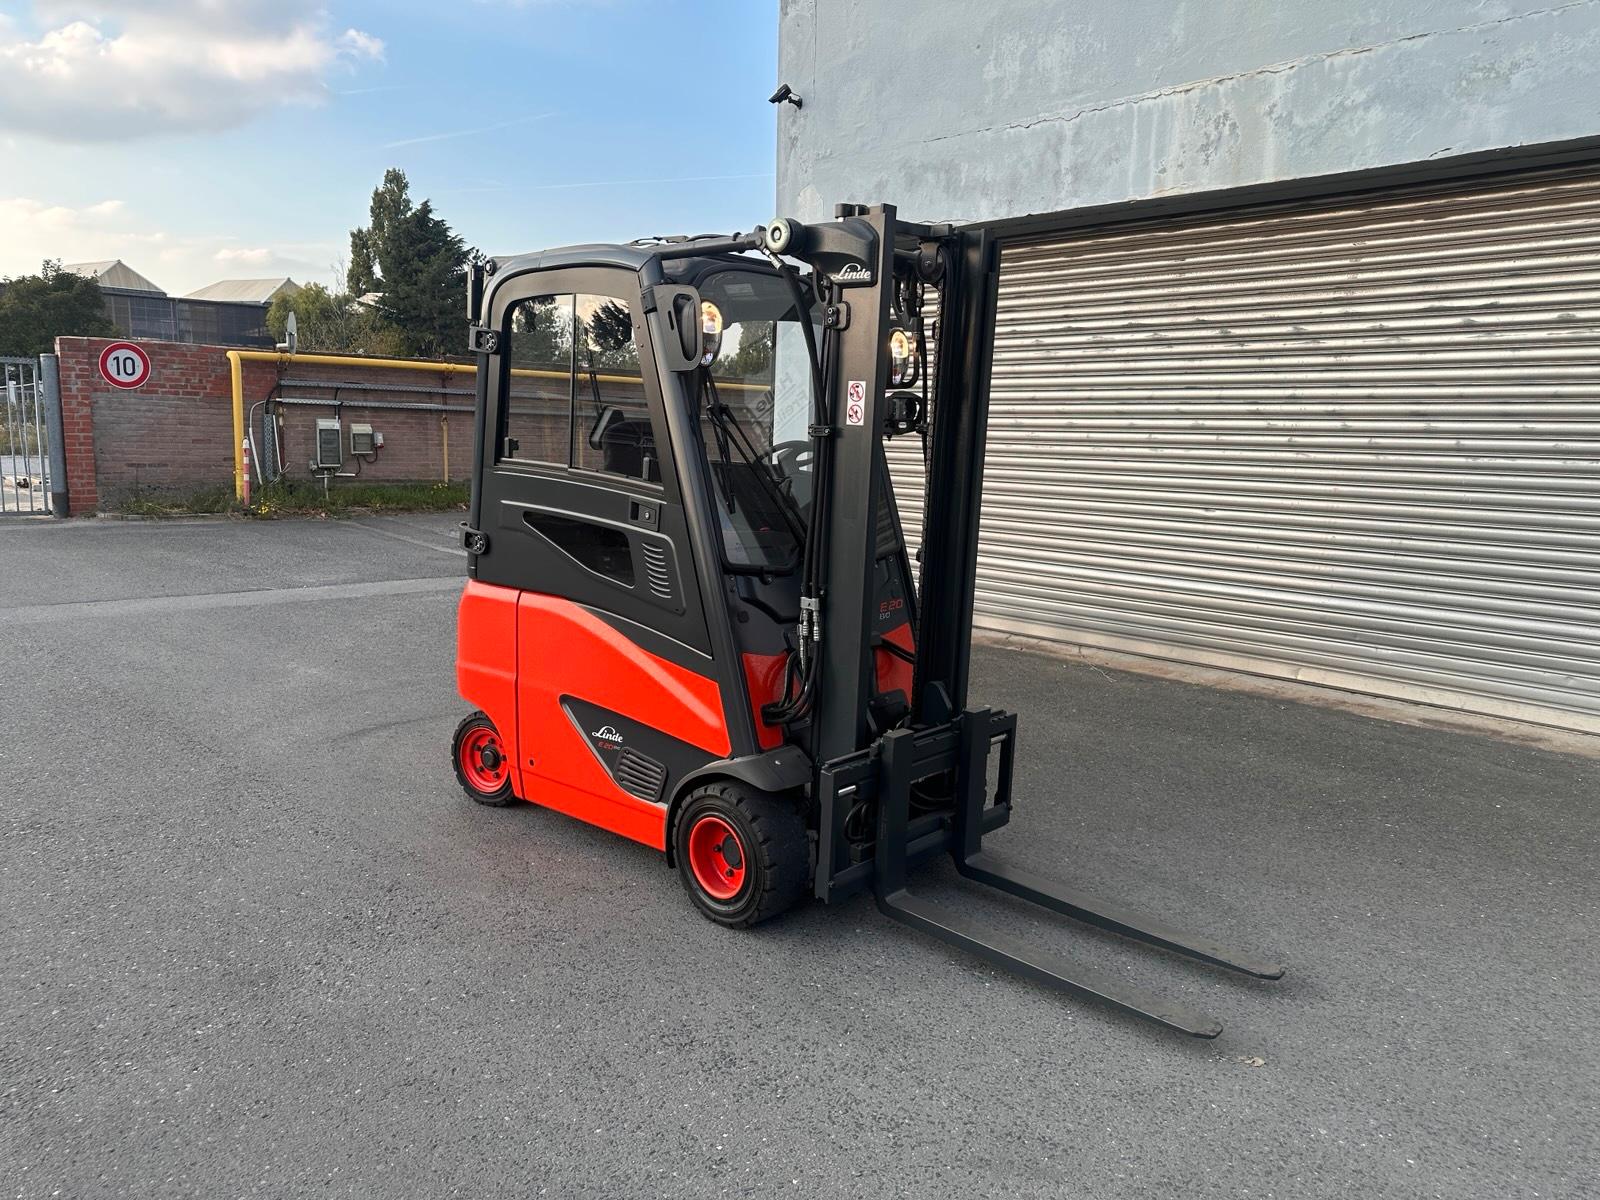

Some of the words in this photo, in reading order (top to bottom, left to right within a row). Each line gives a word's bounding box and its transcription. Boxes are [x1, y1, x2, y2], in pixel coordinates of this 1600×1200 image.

[830, 262, 871, 280] Linde
[113, 355, 136, 377] 10
[592, 726, 623, 743] Linde
